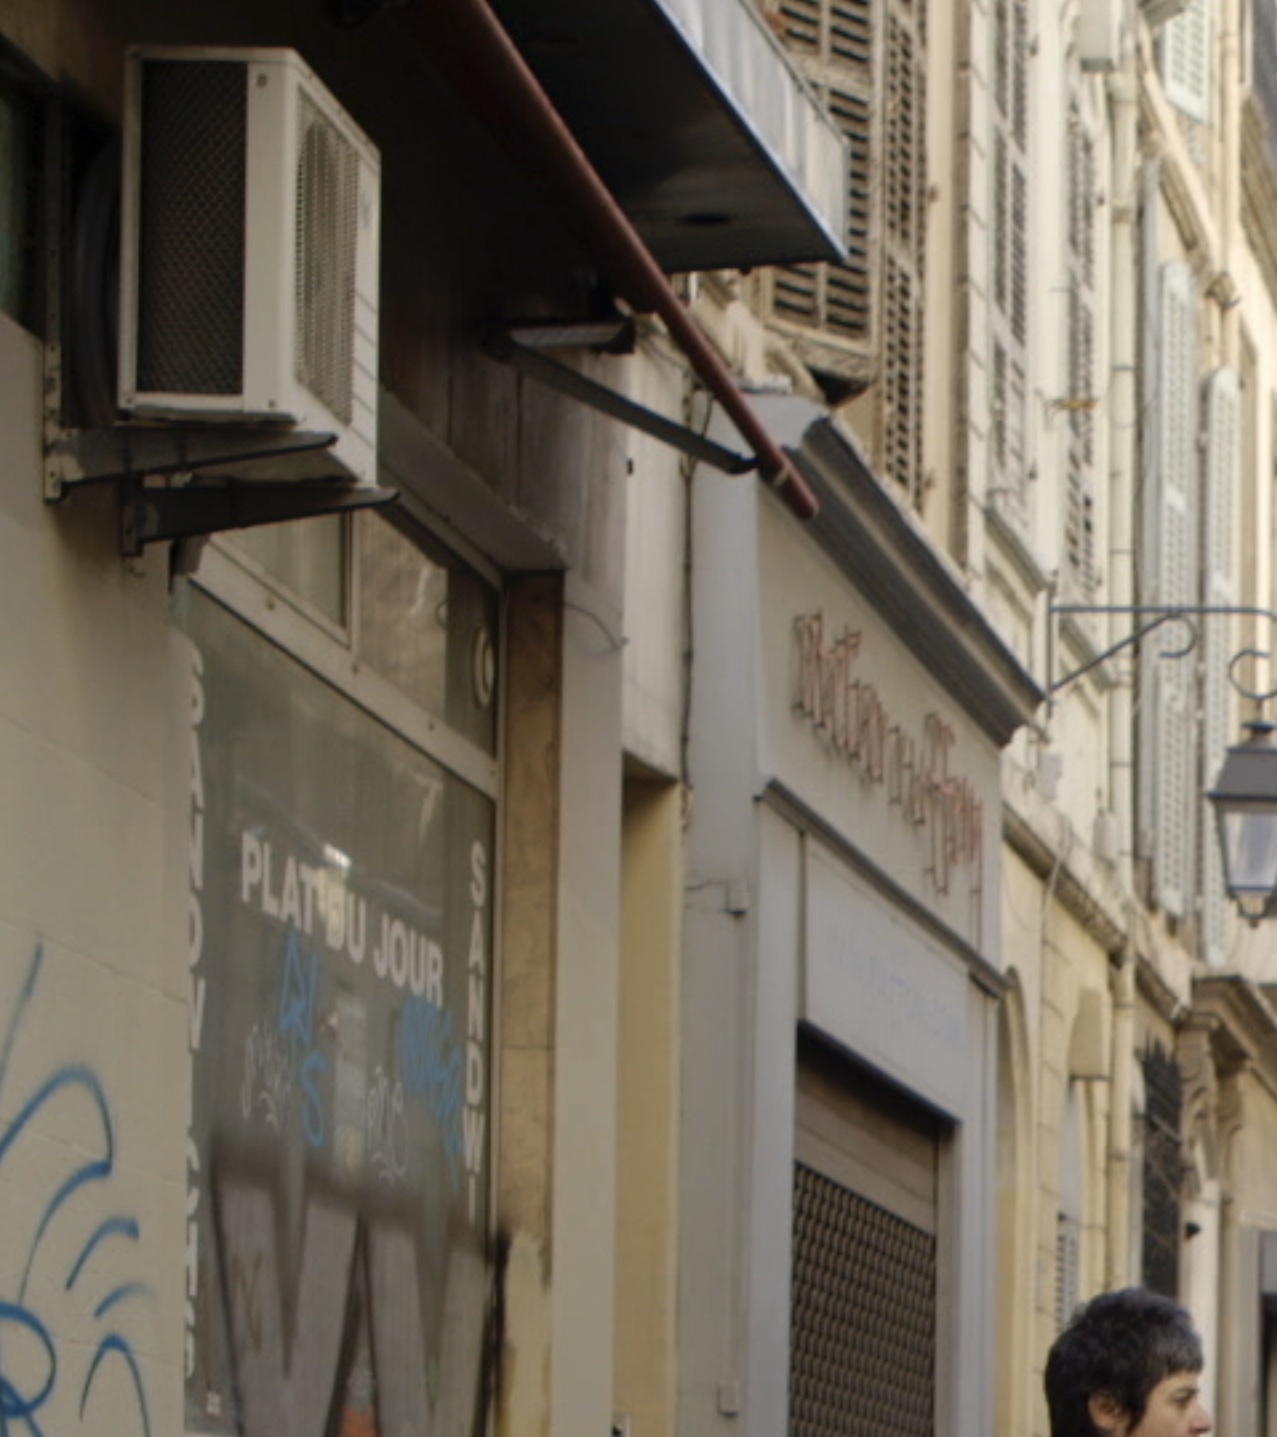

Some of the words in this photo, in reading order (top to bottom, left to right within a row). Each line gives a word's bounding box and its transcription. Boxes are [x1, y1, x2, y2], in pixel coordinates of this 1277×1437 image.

[241, 831, 317, 935] PLAT
[326, 878, 366, 965] DU
[373, 912, 443, 1009] JOUR
